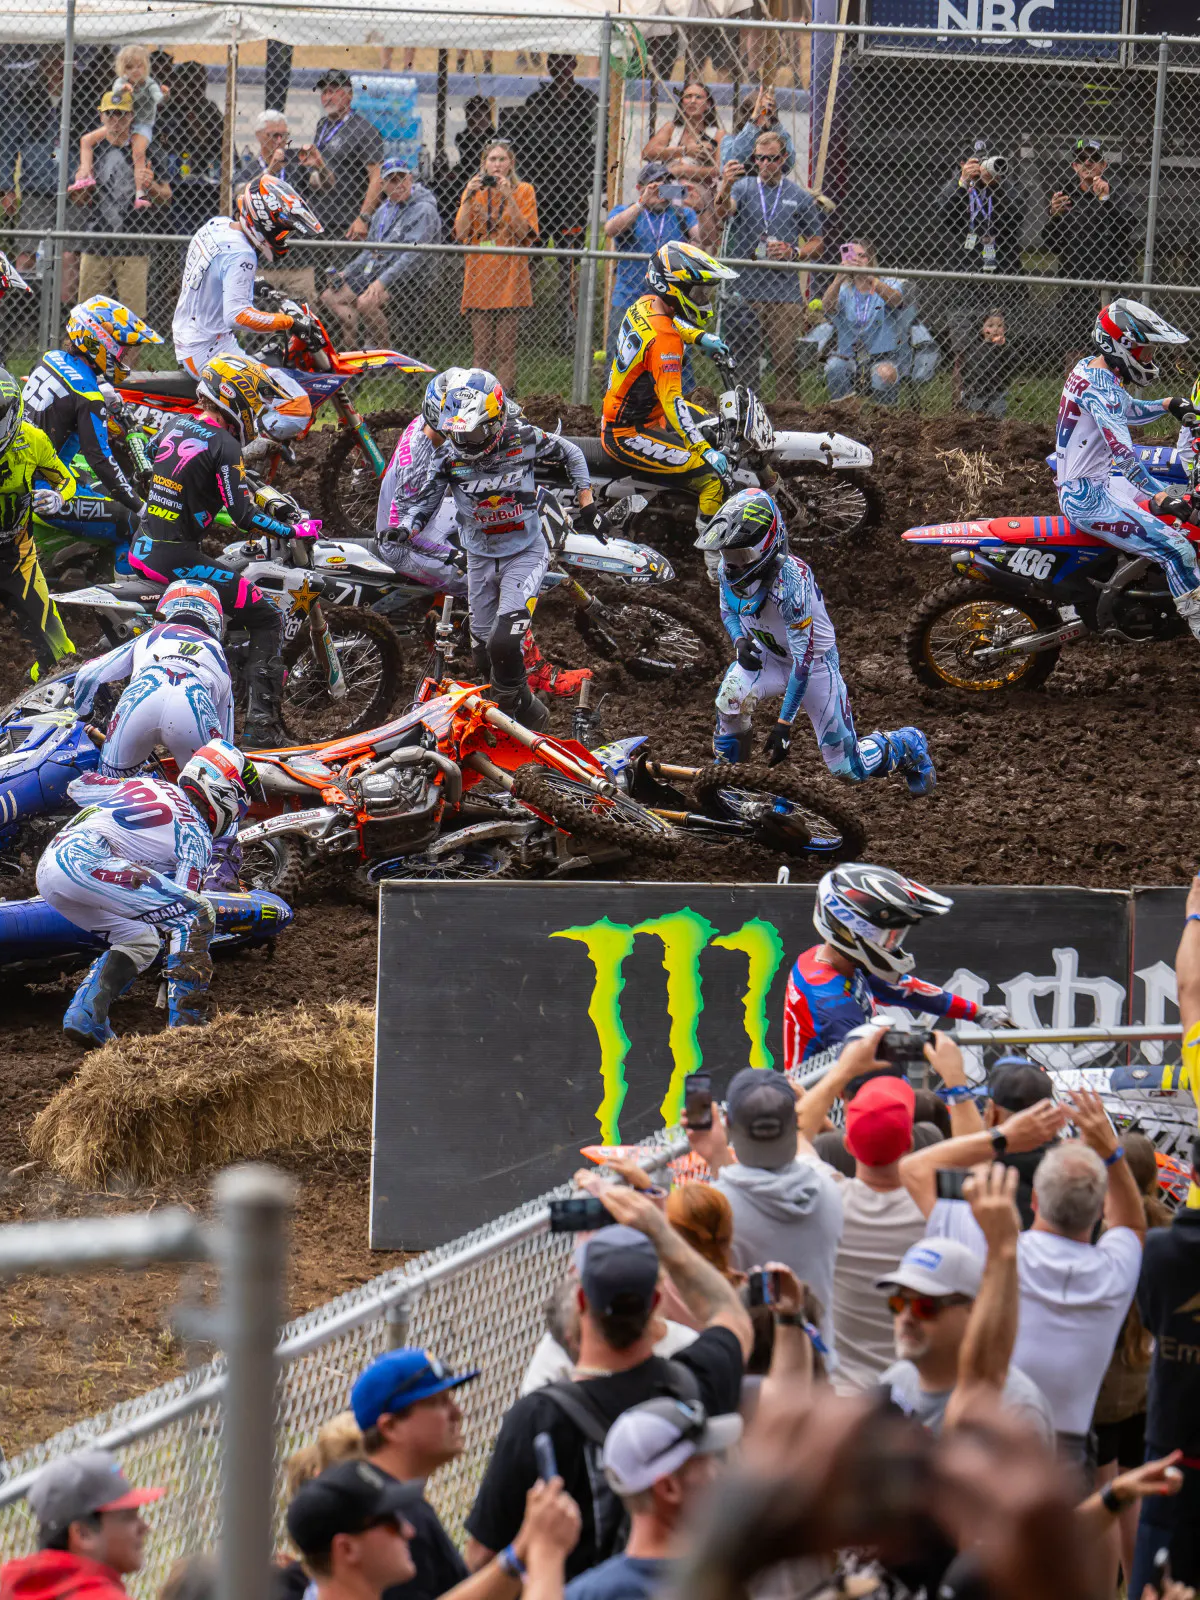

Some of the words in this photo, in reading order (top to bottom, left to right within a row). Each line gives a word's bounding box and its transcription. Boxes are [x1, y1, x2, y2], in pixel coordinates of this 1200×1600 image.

[937, 0, 1055, 49] NBC
[21, 366, 70, 412] 65
[221, 384, 234, 398] BELL
[154, 429, 208, 476] 59
[152, 474, 184, 493] ROCKSTAR
[473, 507, 498, 523] Red
[499, 503, 524, 521] Bull
[1097, 524, 1142, 534] THOR
[1007, 546, 1057, 580] 486
[334, 581, 362, 606] 71
[173, 601, 210, 612] PIERCE
[99, 871, 152, 884] THR
[139, 901, 187, 924] YAMAHA
